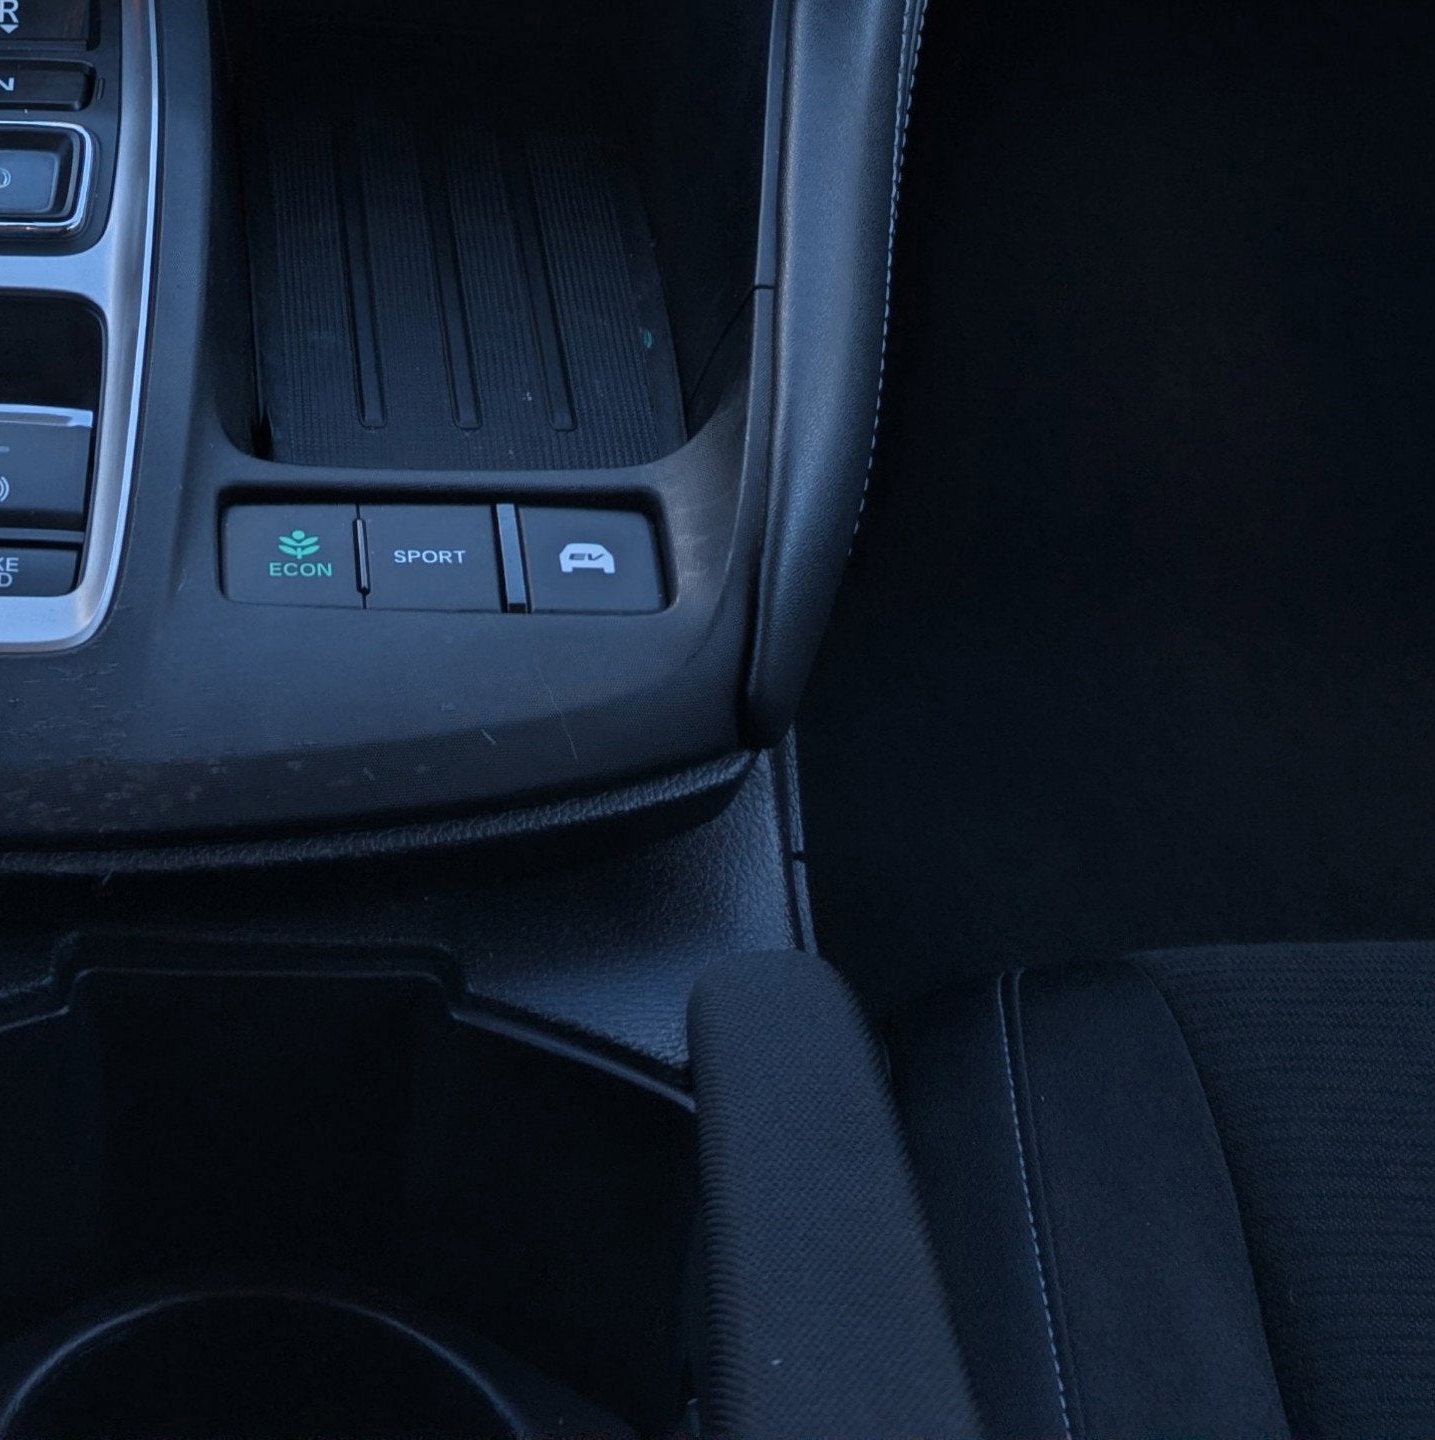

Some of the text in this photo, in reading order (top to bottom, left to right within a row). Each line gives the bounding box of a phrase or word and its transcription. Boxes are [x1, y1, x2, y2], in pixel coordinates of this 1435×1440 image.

[393, 549, 466, 564] SPORT
[568, 552, 606, 563] EV
[269, 561, 332, 578] ECON
